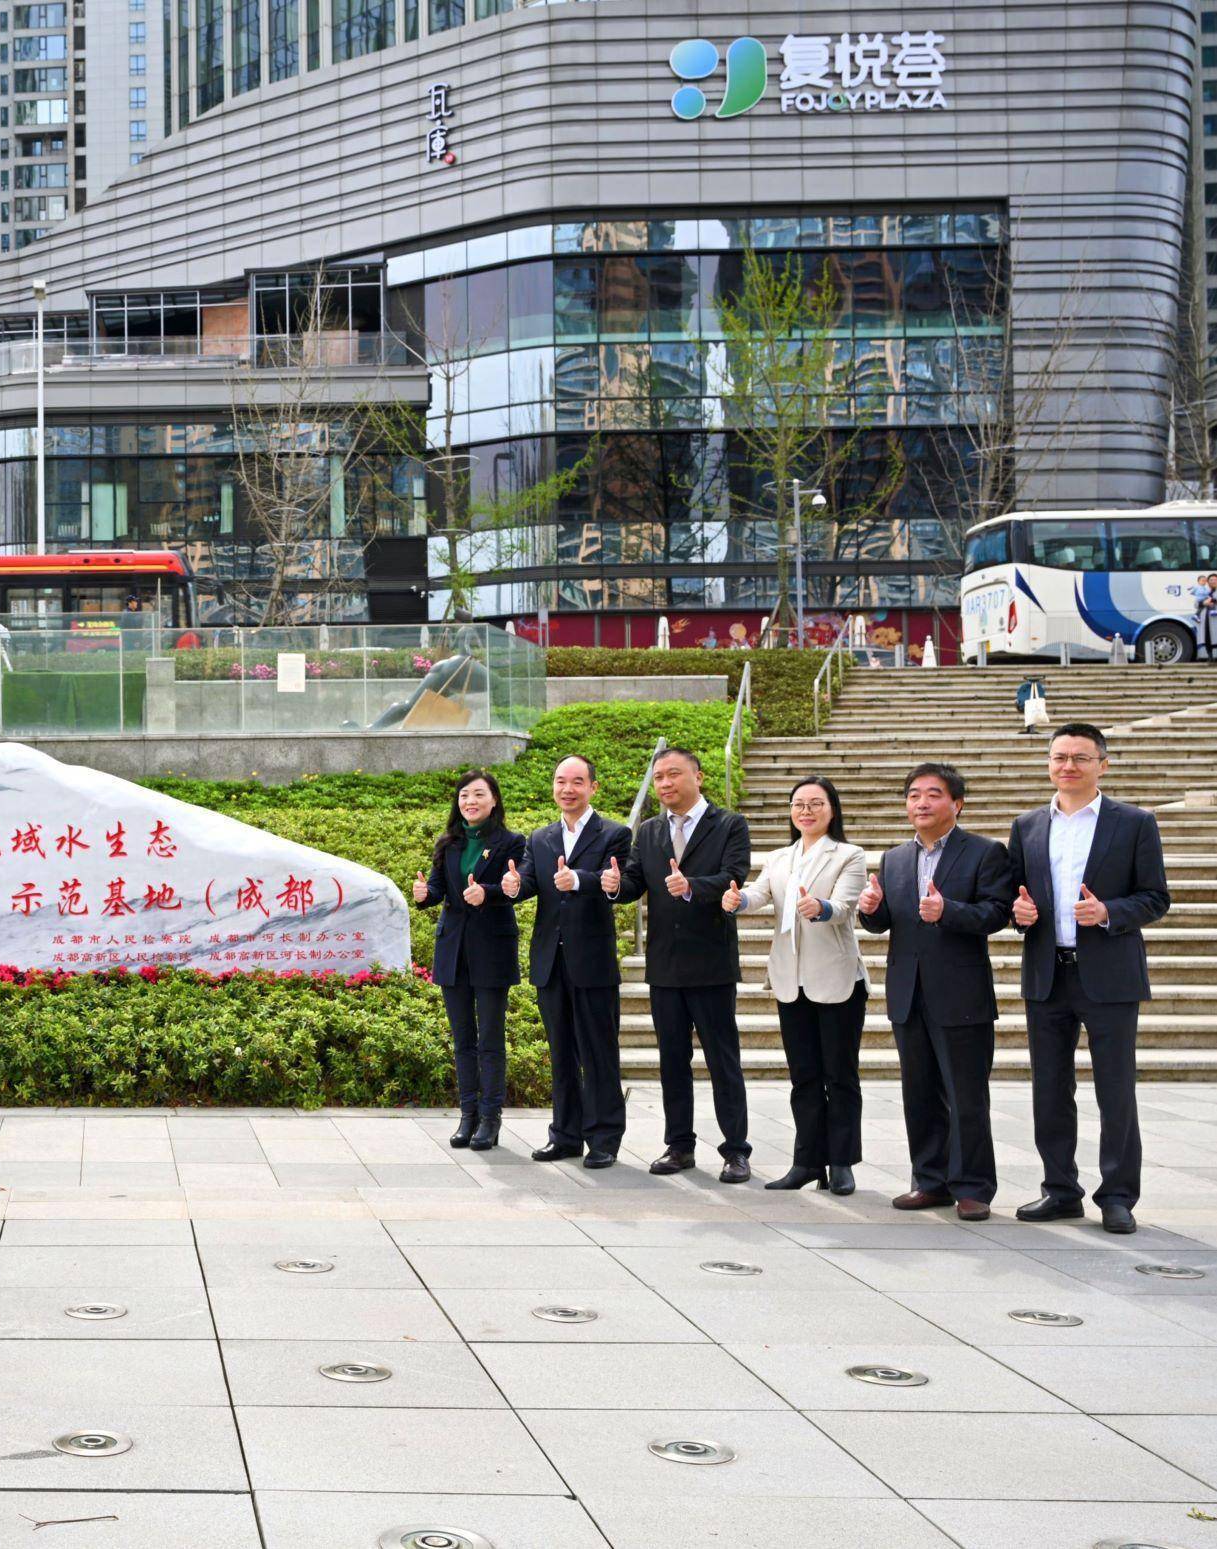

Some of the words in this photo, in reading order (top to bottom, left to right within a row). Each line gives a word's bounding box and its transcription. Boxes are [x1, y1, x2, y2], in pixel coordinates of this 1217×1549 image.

[779, 31, 946, 90] 复悦荟
[52, 934, 192, 945] 成都市人民检察院
[209, 931, 366, 944] 成都市河长制办公室
[52, 951, 192, 963] 成都高新区人民检察院
[209, 949, 366, 961] 成都高新区河长制办公室
